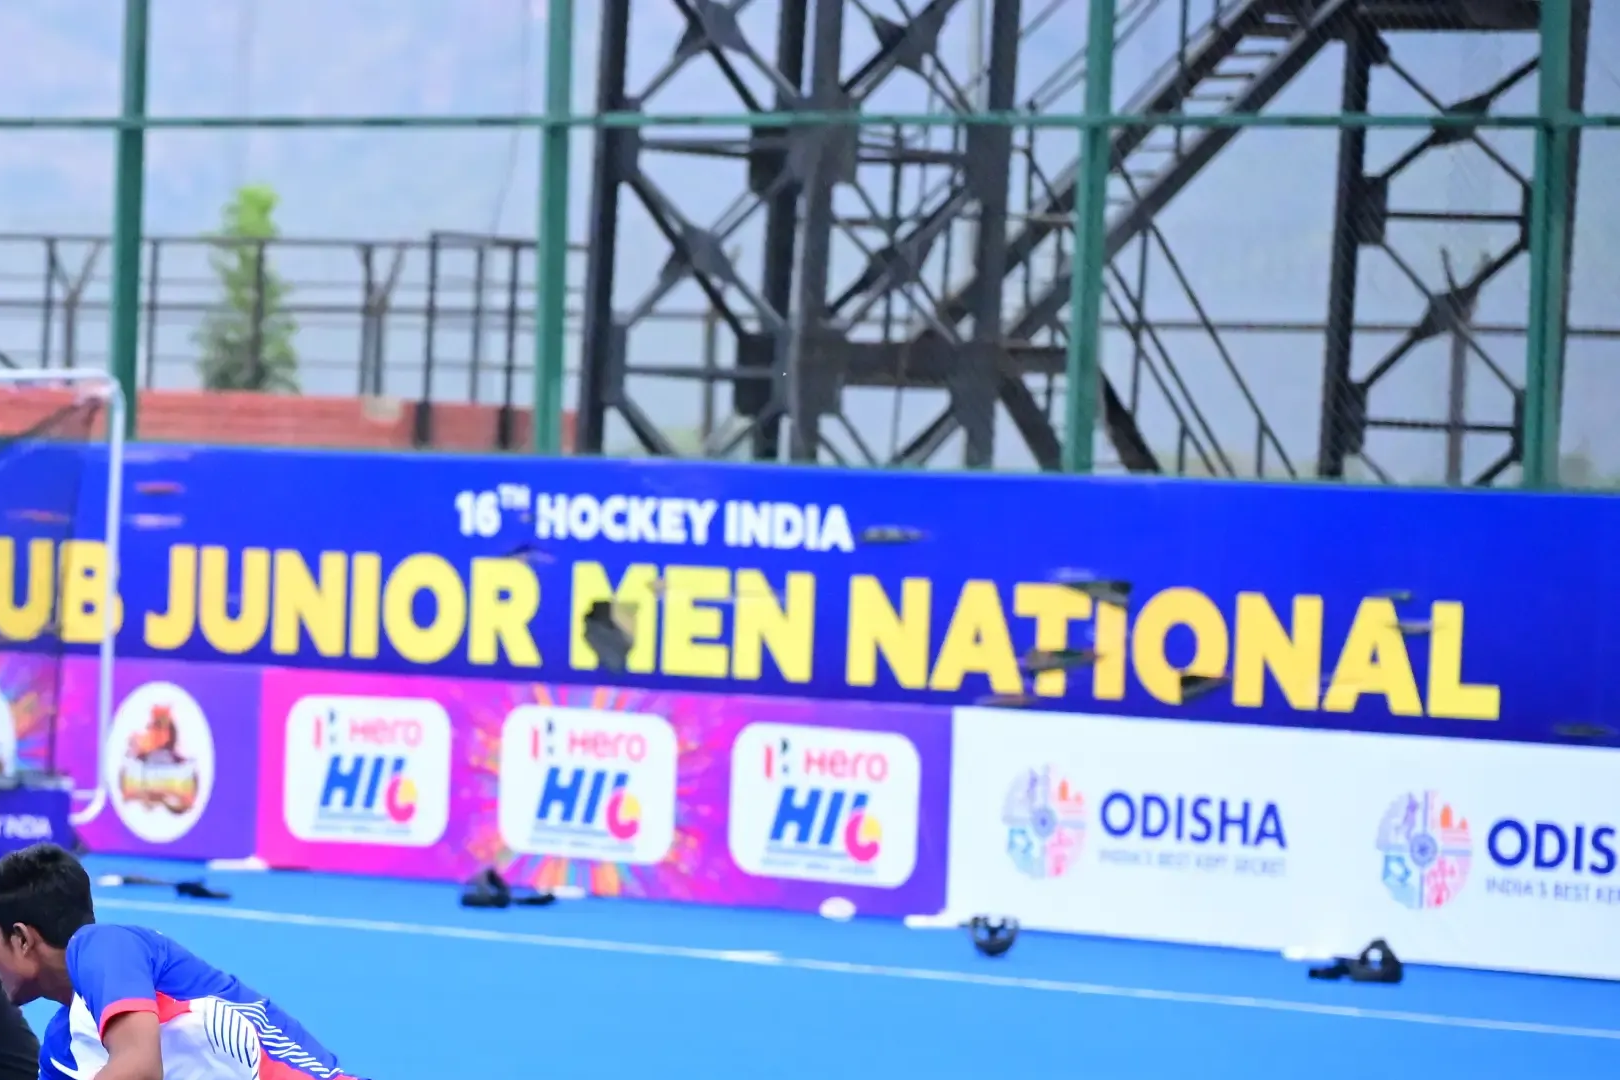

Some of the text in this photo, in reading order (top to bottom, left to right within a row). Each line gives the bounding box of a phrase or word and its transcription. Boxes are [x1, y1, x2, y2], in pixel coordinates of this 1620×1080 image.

[455, 483, 855, 552] 16TH HOCKEY INDIA
[144, 544, 542, 668] JUNIOR
[570, 561, 815, 683] MEN
[845, 573, 1501, 721] NATIONAL
[803, 750, 889, 783] Hero
[1100, 791, 1287, 850] ODISHA
[1487, 818, 1617, 875] ODIS
